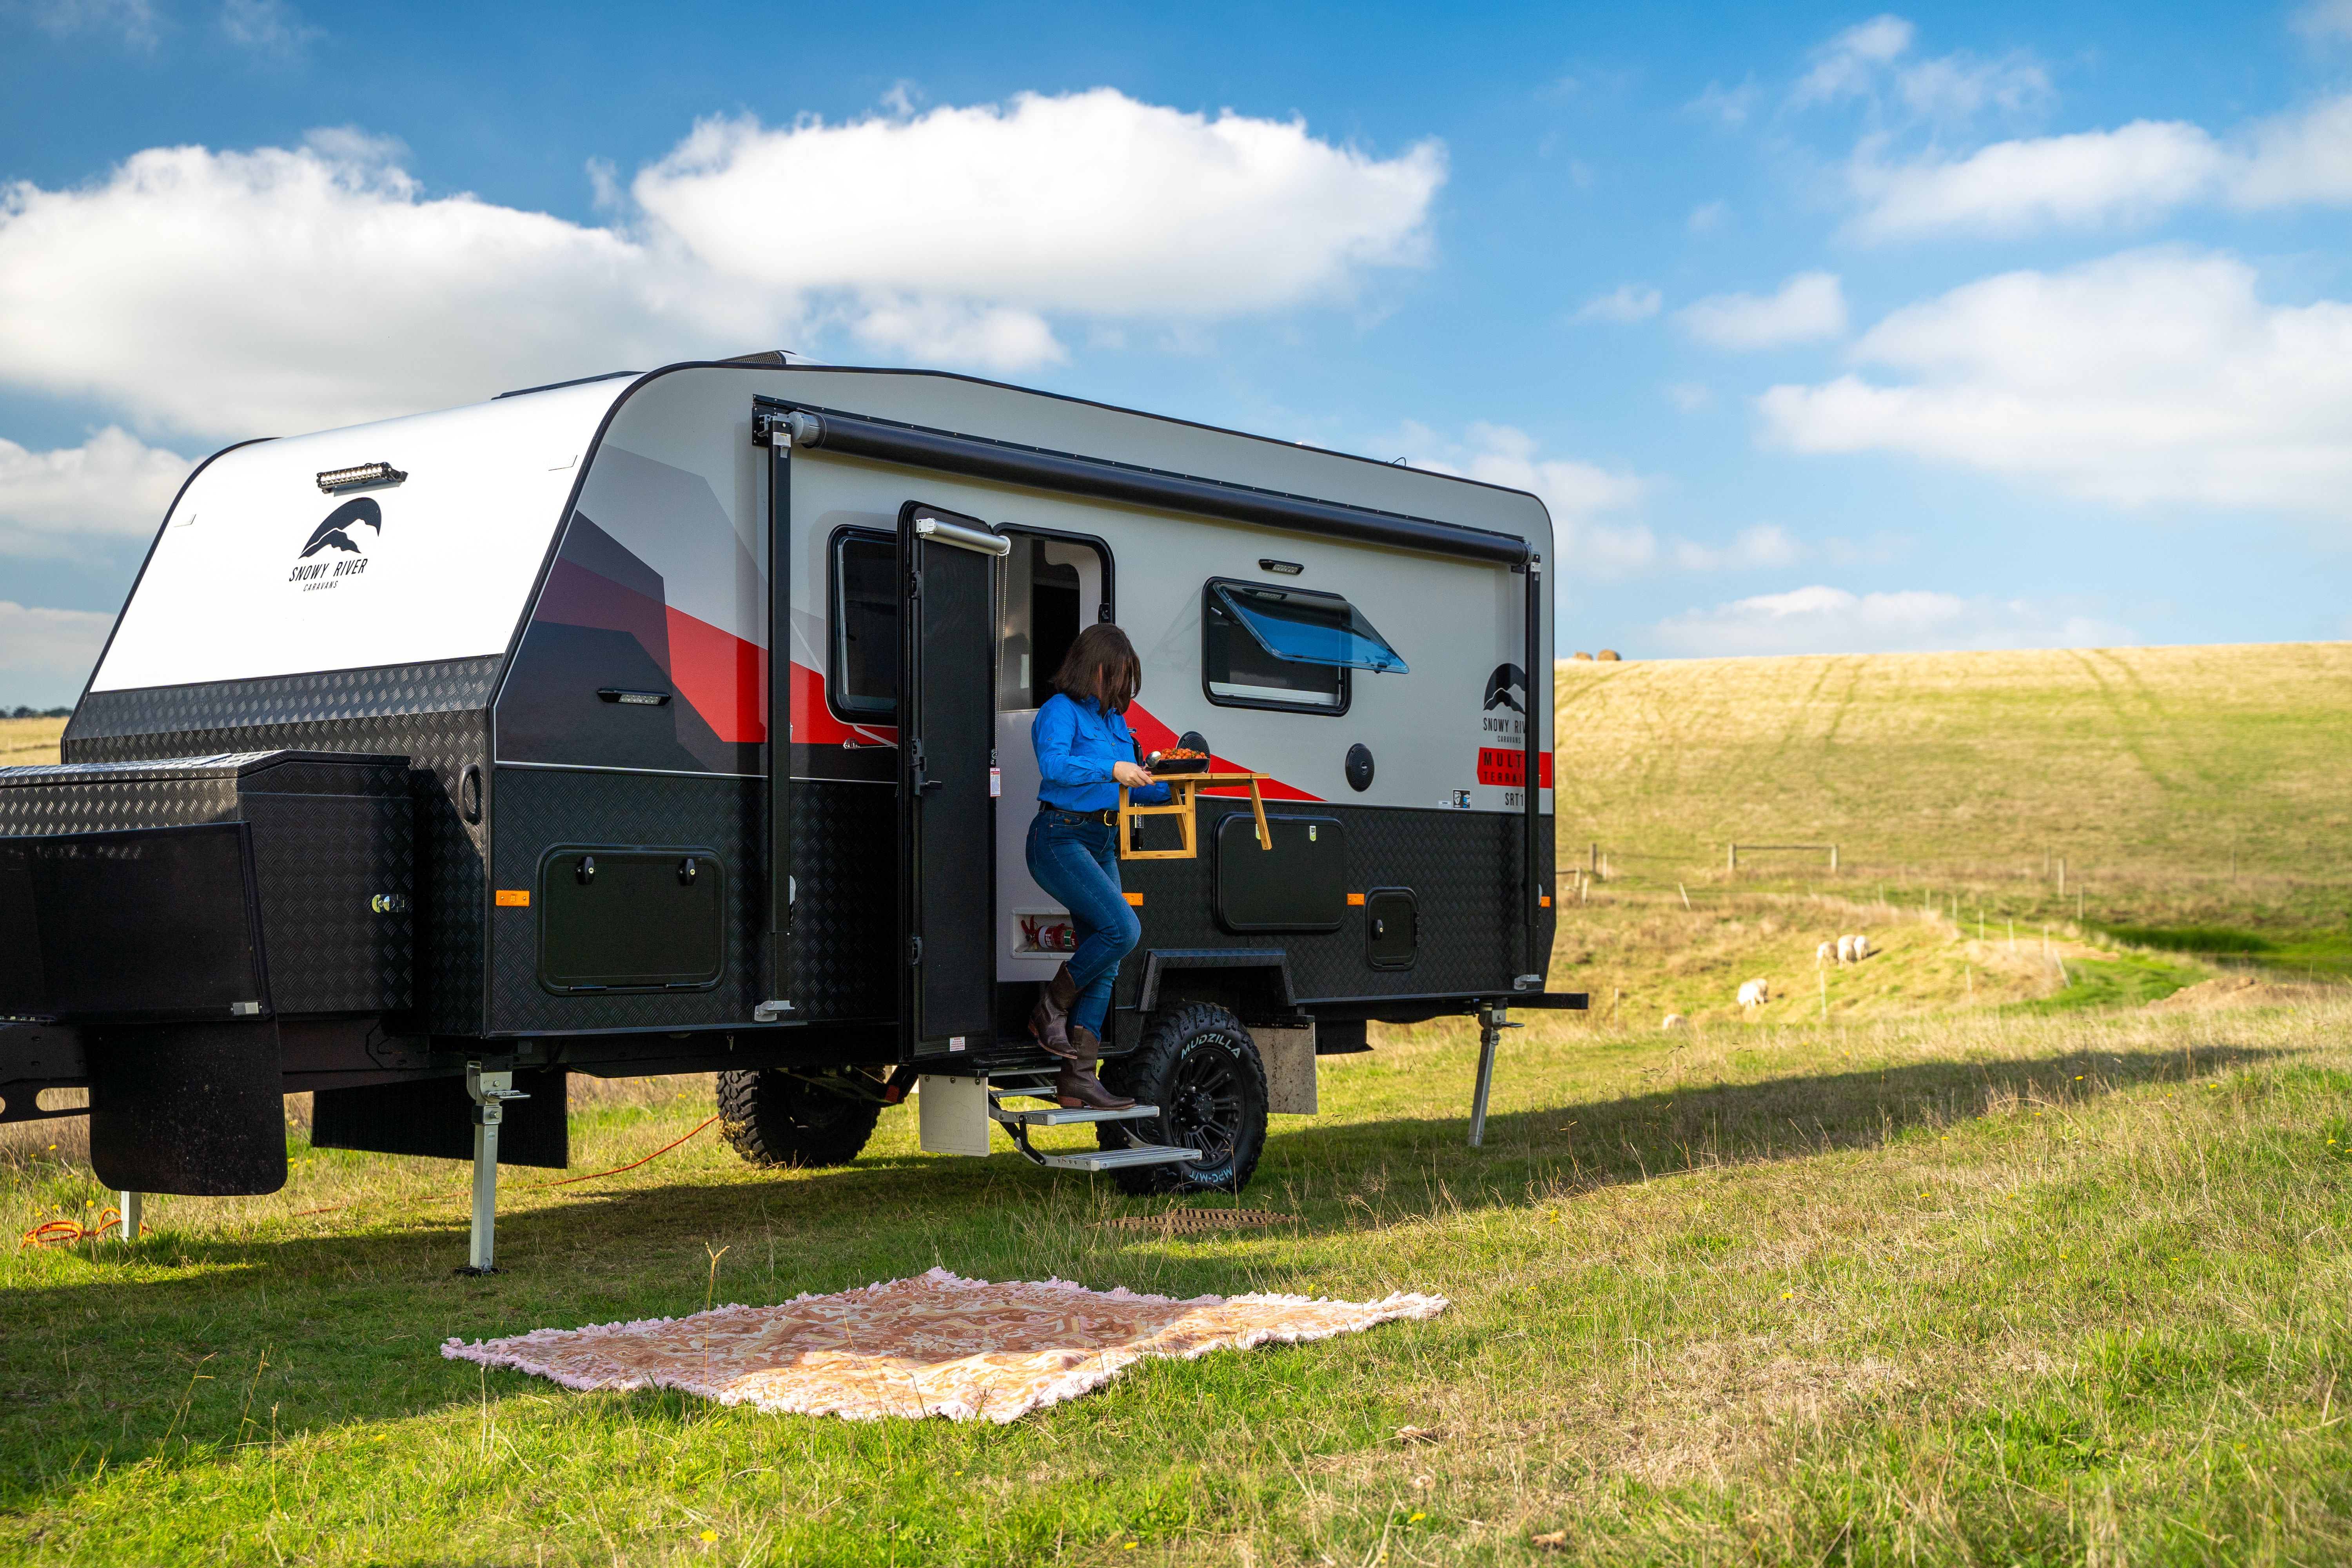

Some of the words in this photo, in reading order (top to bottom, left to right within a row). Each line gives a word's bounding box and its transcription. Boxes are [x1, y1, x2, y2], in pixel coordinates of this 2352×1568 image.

[289, 563, 330, 582] SNOWY
[333, 558, 368, 577] RIVER
[303, 581, 338, 592] CARAVANS
[1483, 717, 1509, 732] SNOWY
[1515, 720, 1525, 734] RIV
[1498, 735, 1521, 744] CARAVANS
[1484, 751, 1522, 768] MULT
[1483, 771, 1522, 783] TERRAI
[1505, 792, 1524, 806] SRT1
[1181, 1033, 1241, 1060] MUDZILLA
[1189, 1166, 1232, 1183] MPC-M/T
